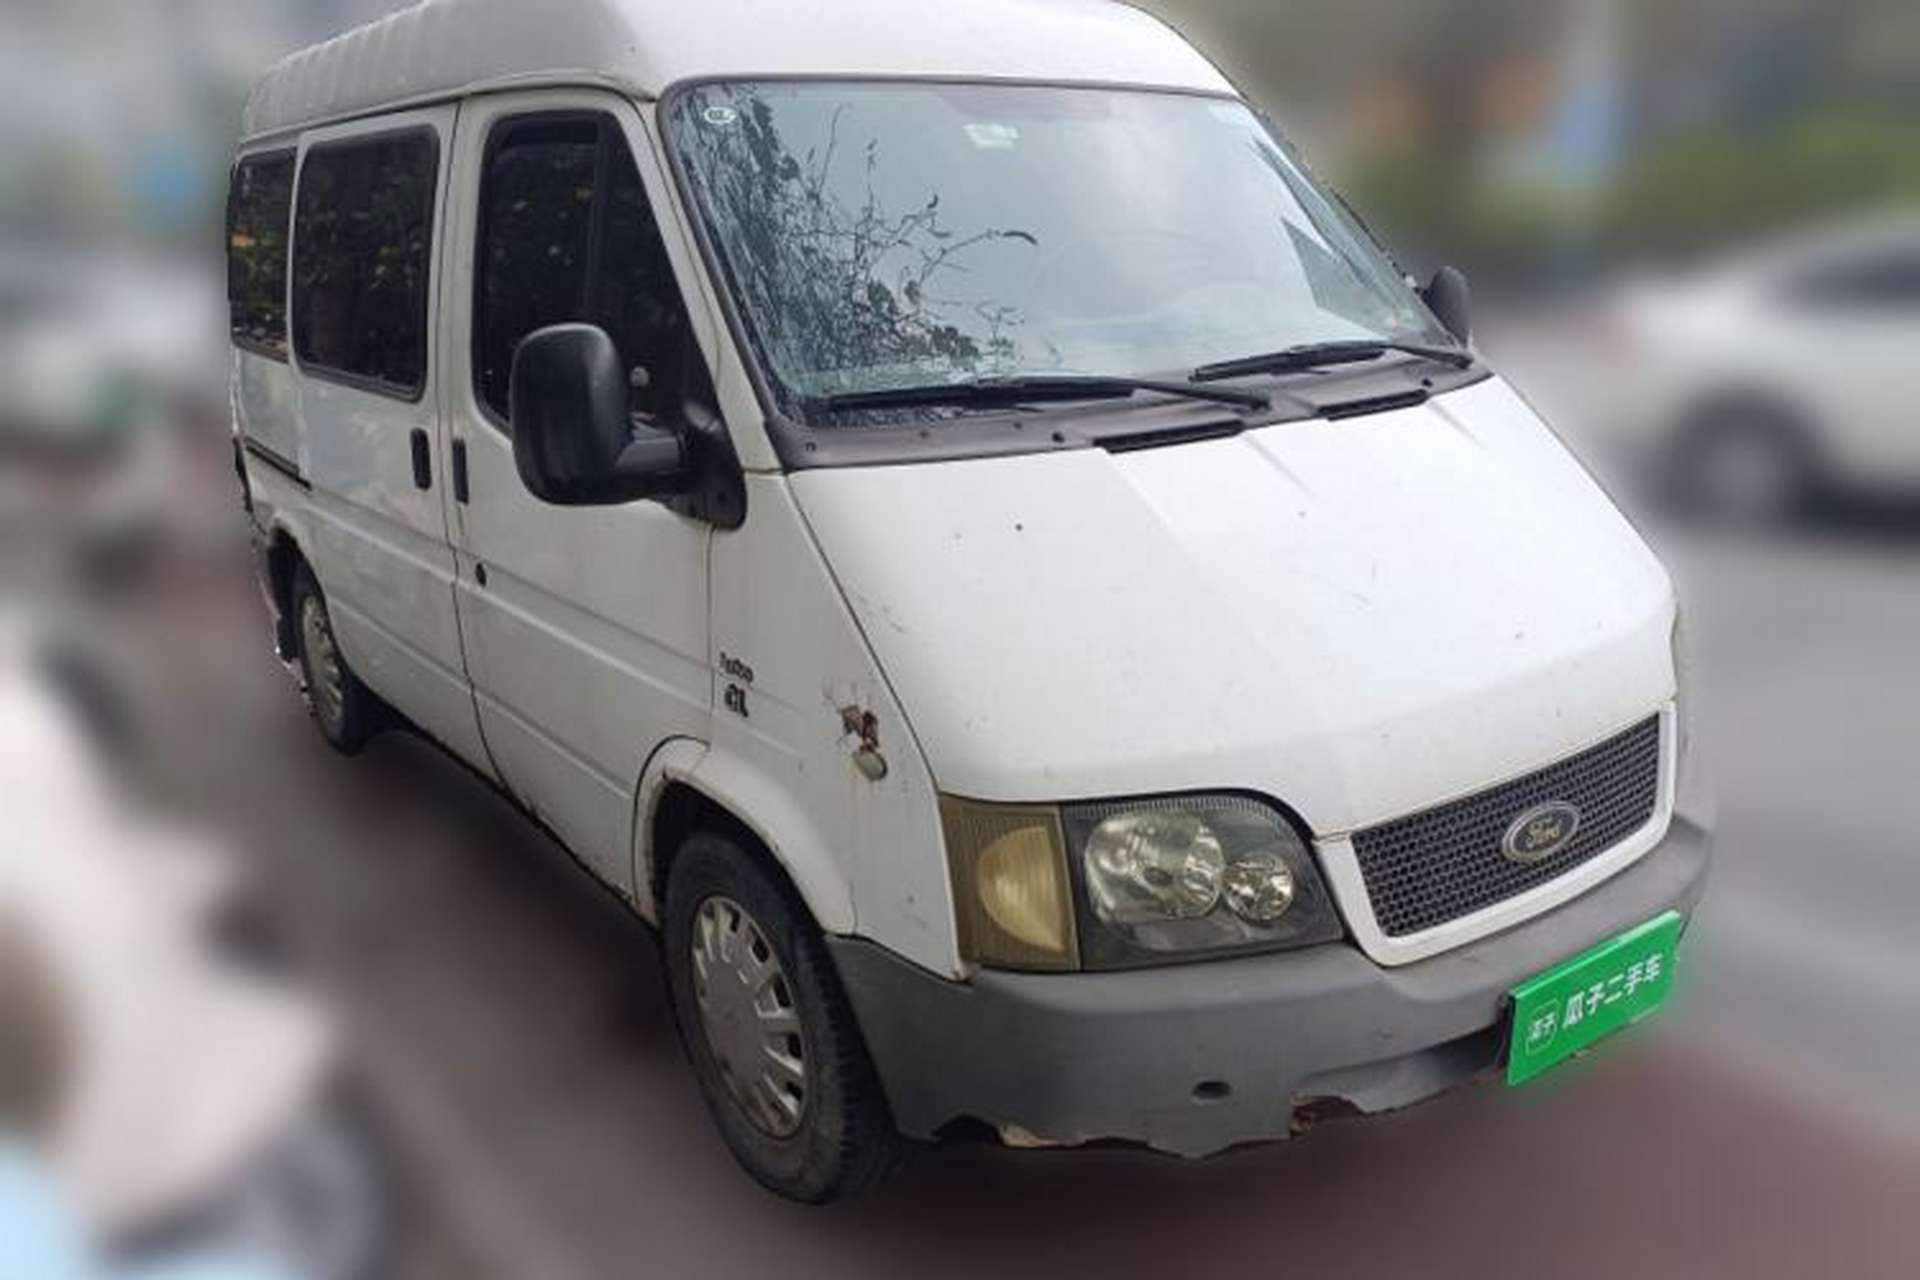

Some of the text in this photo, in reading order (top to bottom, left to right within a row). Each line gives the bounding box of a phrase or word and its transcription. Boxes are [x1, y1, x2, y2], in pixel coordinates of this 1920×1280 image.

[1562, 953, 1664, 1029] 瓜子二手车
